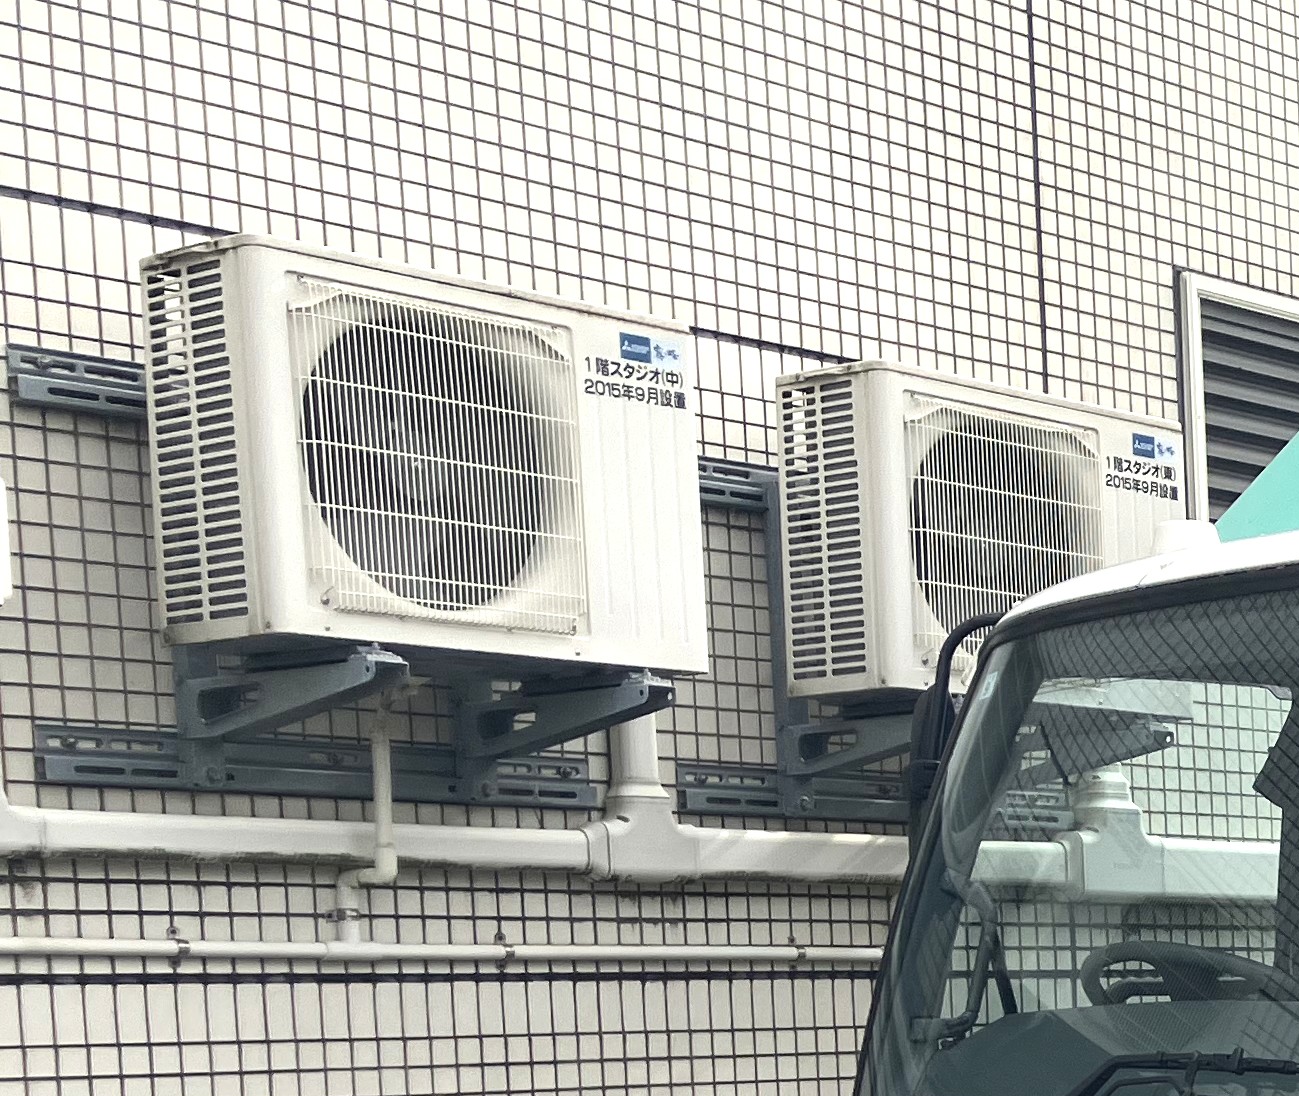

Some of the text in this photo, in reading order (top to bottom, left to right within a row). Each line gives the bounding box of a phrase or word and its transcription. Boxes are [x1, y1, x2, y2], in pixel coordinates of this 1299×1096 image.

[584, 379, 687, 409] 2015年9月設置
[1105, 474, 1179, 501] 2015年9月設置
